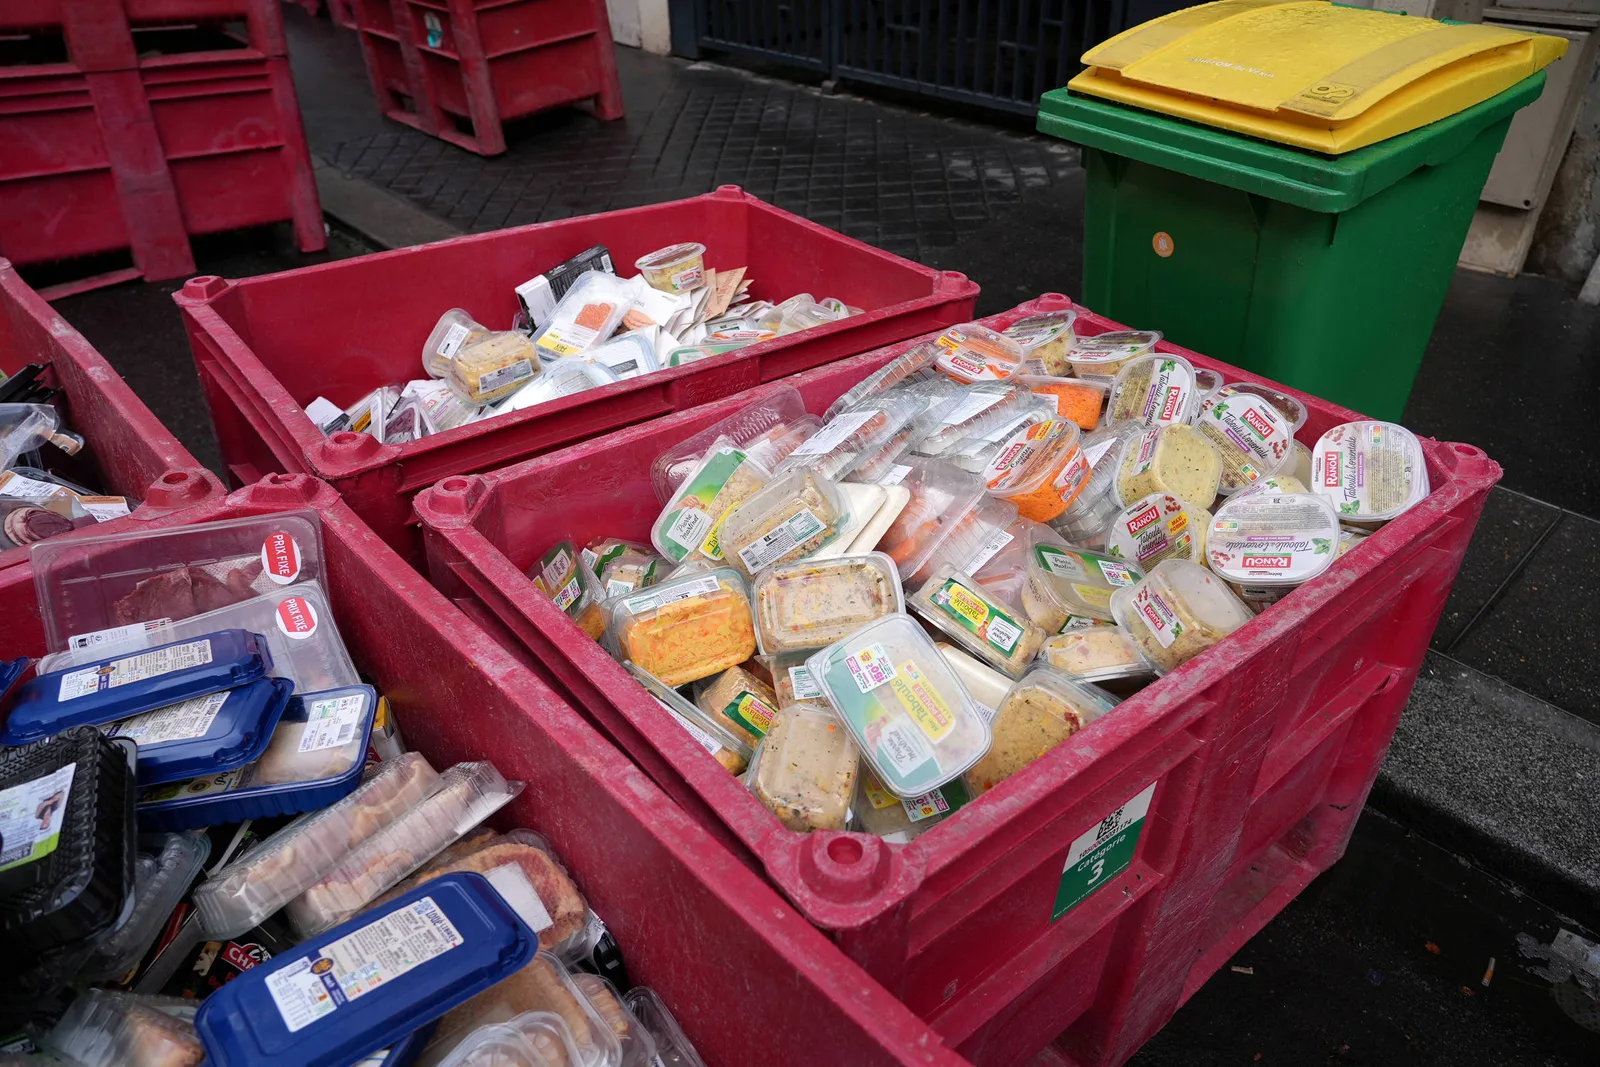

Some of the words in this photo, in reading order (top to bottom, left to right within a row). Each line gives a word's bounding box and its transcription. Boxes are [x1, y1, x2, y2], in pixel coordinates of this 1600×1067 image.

[951, 355, 981, 374] RANOU
[1161, 386, 1179, 419] RANOU
[1220, 409, 1246, 436] Taboulé
[1240, 430, 1270, 460] l'orientale
[1243, 409, 1271, 437] RANOU
[996, 442, 1022, 471] RANOU
[1344, 436, 1356, 469] l'orientale
[1327, 452, 1337, 484] RANOU
[1343, 473, 1356, 501] Taboulé
[1127, 508, 1159, 532] RANOU
[1168, 517, 1189, 533] FORMAT
[1169, 514, 1183, 525] MAXI
[272, 533, 286, 555] PRIX
[1134, 523, 1163, 546] Taboulé
[1224, 541, 1269, 551] l'orientale
[1274, 540, 1312, 552] Taboulé
[276, 554, 290, 575] FIXE
[1245, 556, 1287, 566] RANOU
[283, 596, 301, 617] PRIX
[952, 597, 980, 620] Taboulé
[956, 591, 978, 609] POULET
[975, 605, 984, 614] AU
[290, 612, 308, 632] FIXE
[1144, 605, 1164, 629] RANOU
[891, 677, 930, 722] Taboulé
[912, 683, 939, 715] POULET
[740, 703, 772, 728] oleslaw
[934, 712, 948, 726] AU
[883, 734, 906, 764] Pierre
[1078, 834, 1126, 872] Catégorie
[1087, 859, 1105, 885] 3
